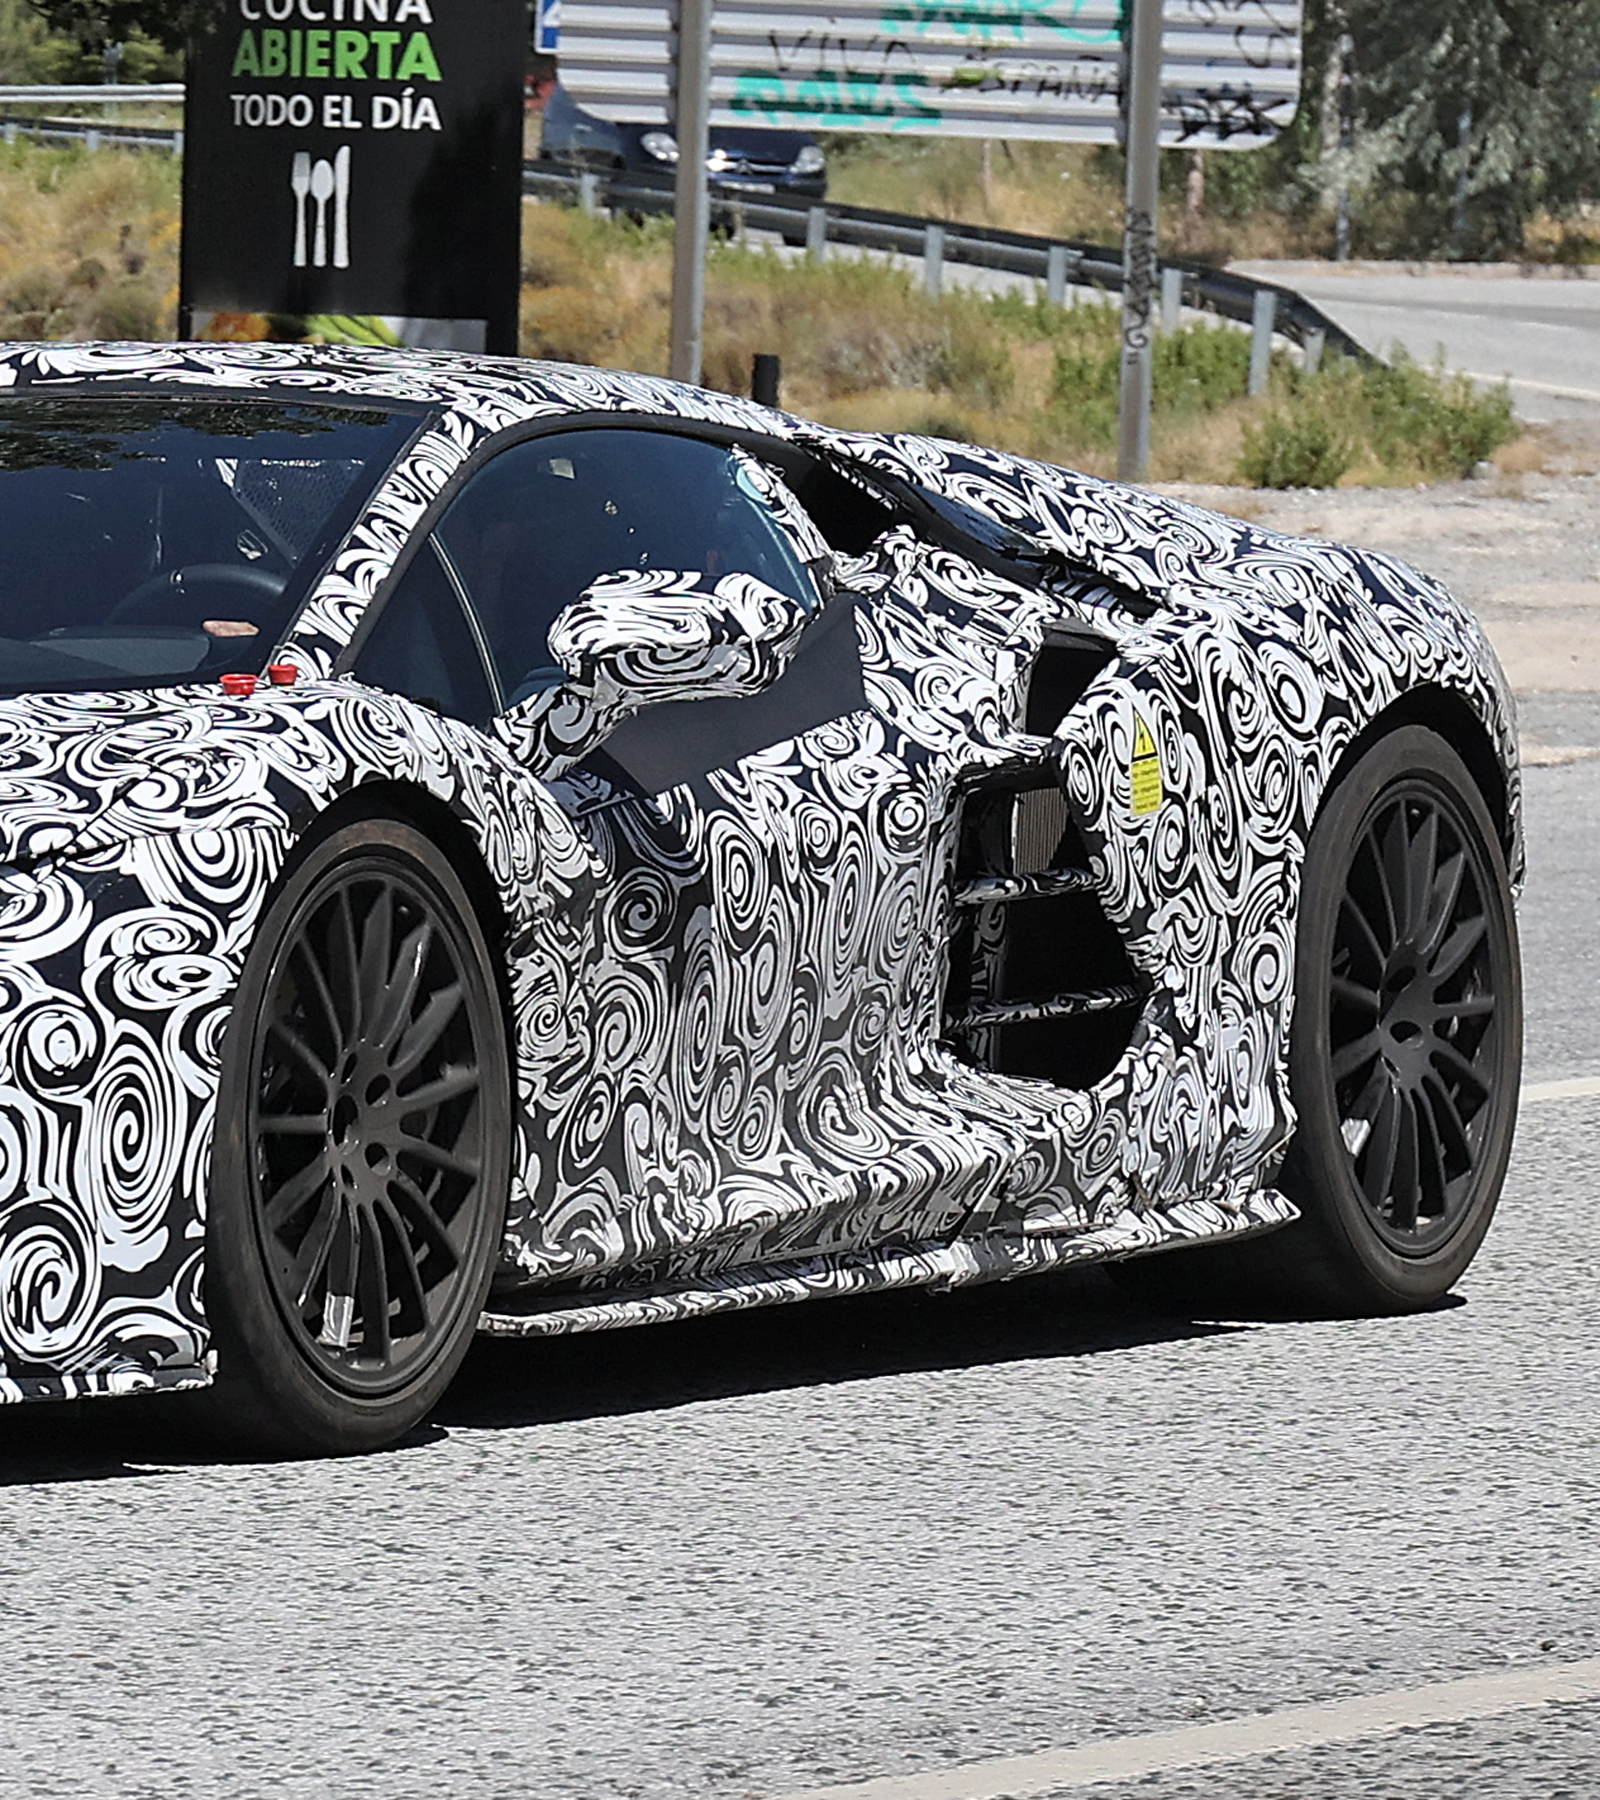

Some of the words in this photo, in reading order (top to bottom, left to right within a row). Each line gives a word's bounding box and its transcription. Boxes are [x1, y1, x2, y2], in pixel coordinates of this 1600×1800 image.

[239, 0, 433, 24] COCINA
[231, 28, 443, 82] ABIERTA
[229, 93, 314, 128] TODO
[322, 94, 363, 129] EL
[371, 86, 443, 131] DÍA
